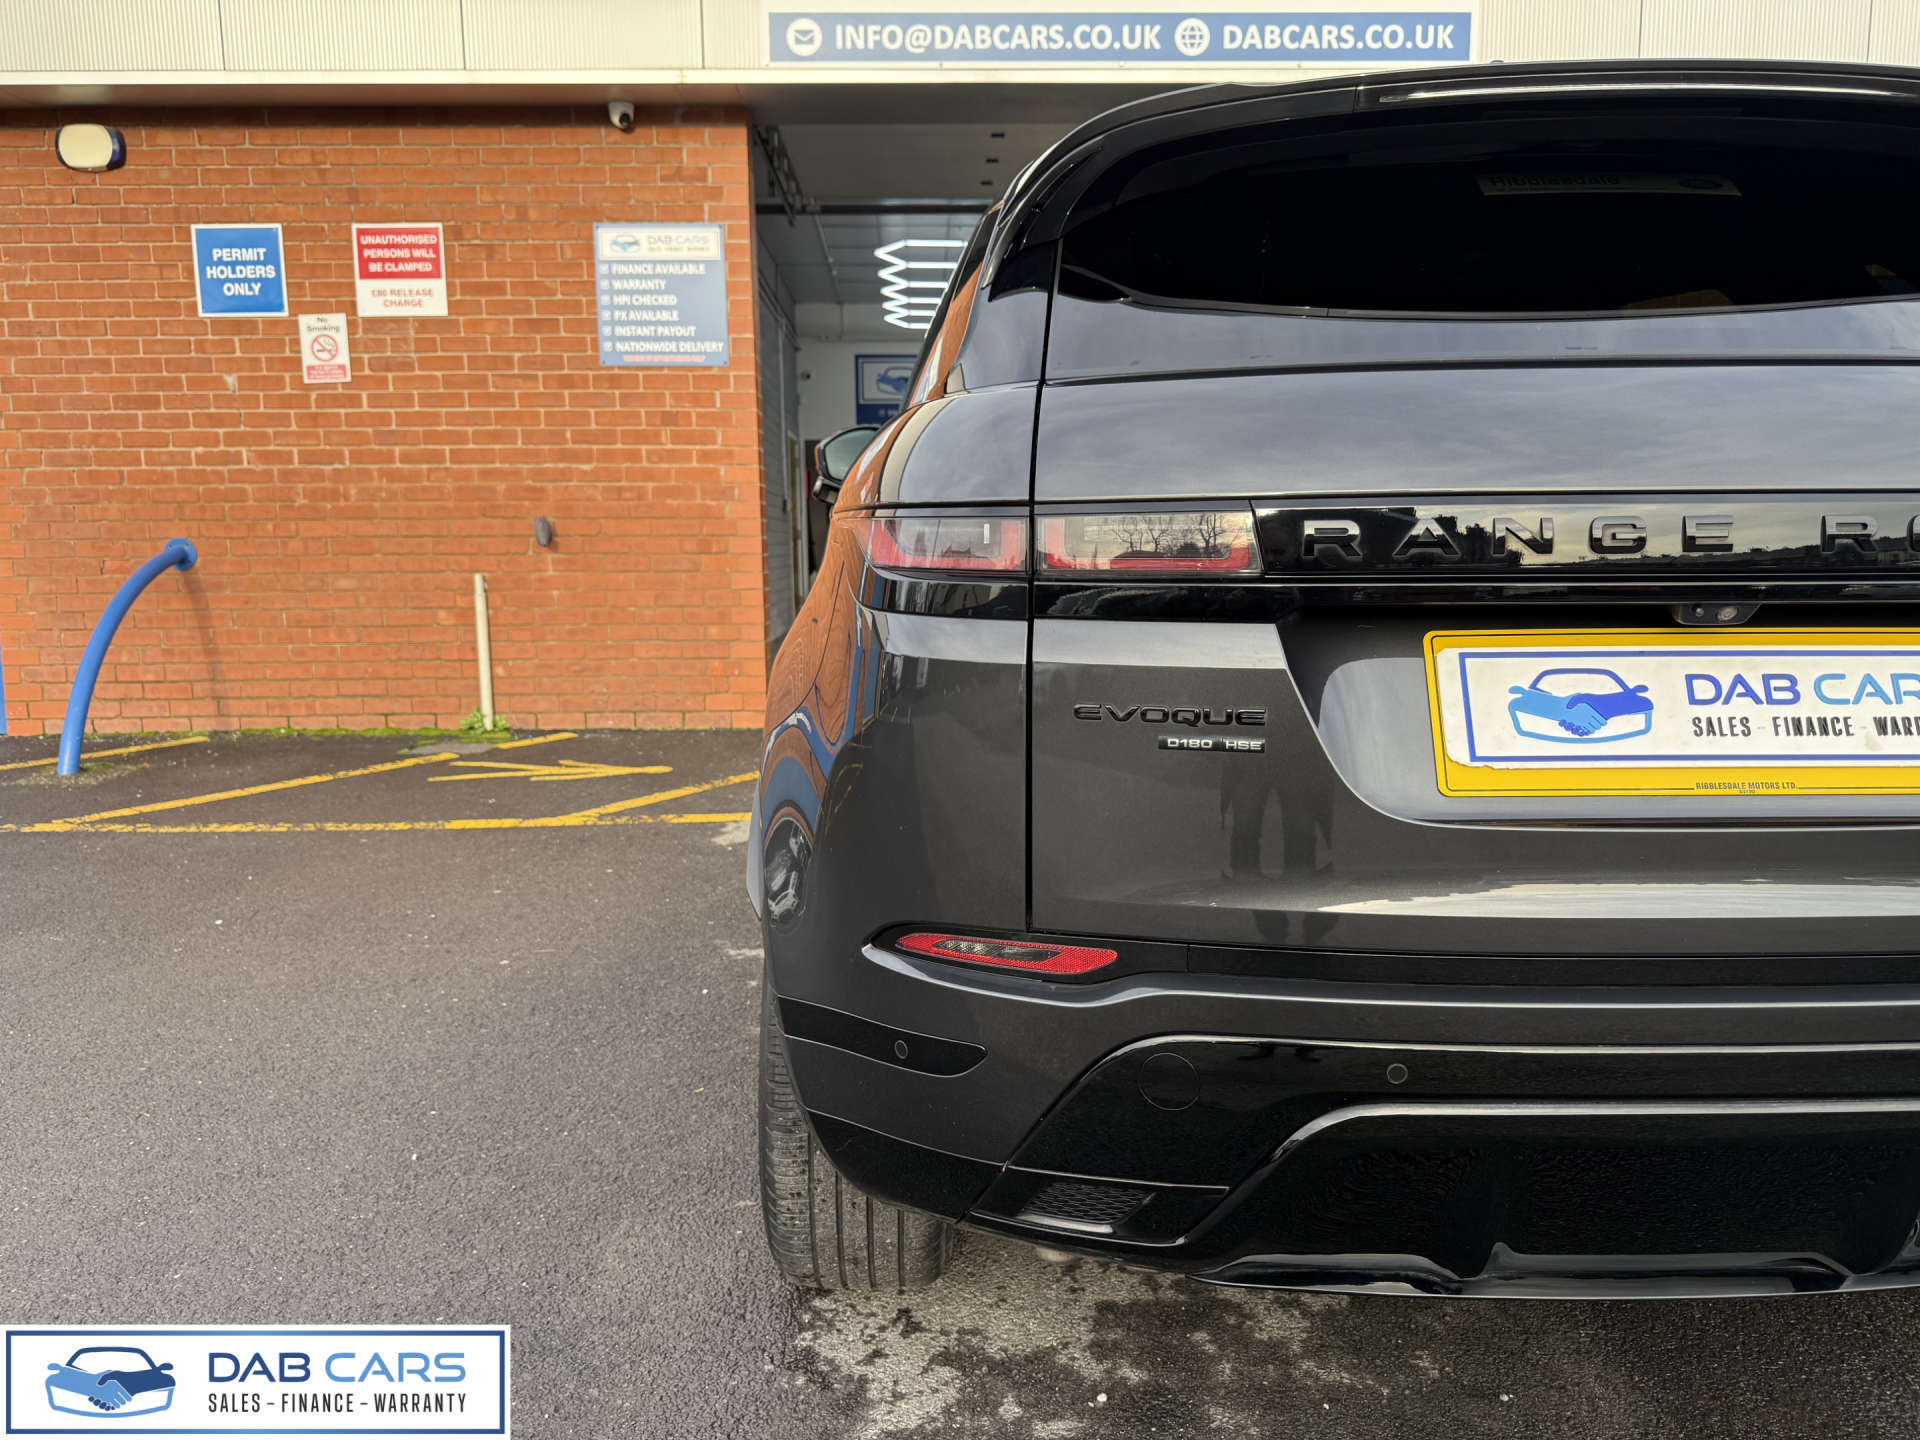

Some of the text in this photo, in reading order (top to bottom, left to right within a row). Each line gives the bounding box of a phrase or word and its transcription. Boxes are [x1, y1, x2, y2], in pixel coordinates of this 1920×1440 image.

[835, 24, 1162, 53] INFO@DABCARS.CO.UK
[1223, 24, 1455, 50] DABCARS.CO.UK
[361, 233, 437, 245] UNAUTHORISED
[212, 247, 267, 262] PERMIT
[363, 247, 437, 259] PERSONS WILL
[206, 264, 277, 279] HOLDERS
[368, 261, 433, 273] BE CLAMPED
[612, 263, 706, 275] FINANCE AVAILABLE
[223, 281, 262, 297] ONLY
[613, 279, 666, 290] WARRANTY
[632, 294, 677, 306] CHECKED
[628, 310, 679, 321] AVAILABLE
[615, 325, 696, 337] INSTANT PAYOUT
[615, 341, 724, 353] NATIONWIDE DELIVERY
[1302, 513, 1920, 560] RANGE R
[1684, 673, 1801, 705] DAB
[1073, 703, 1266, 727] EVOQUE
[1692, 715, 1752, 738] SALES
[1772, 716, 1855, 737] FINANCE
[1167, 738, 1262, 751] D180 HSE
[1695, 781, 1746, 790] RIBBLESDALE
[1748, 781, 1780, 790] MOTORS
